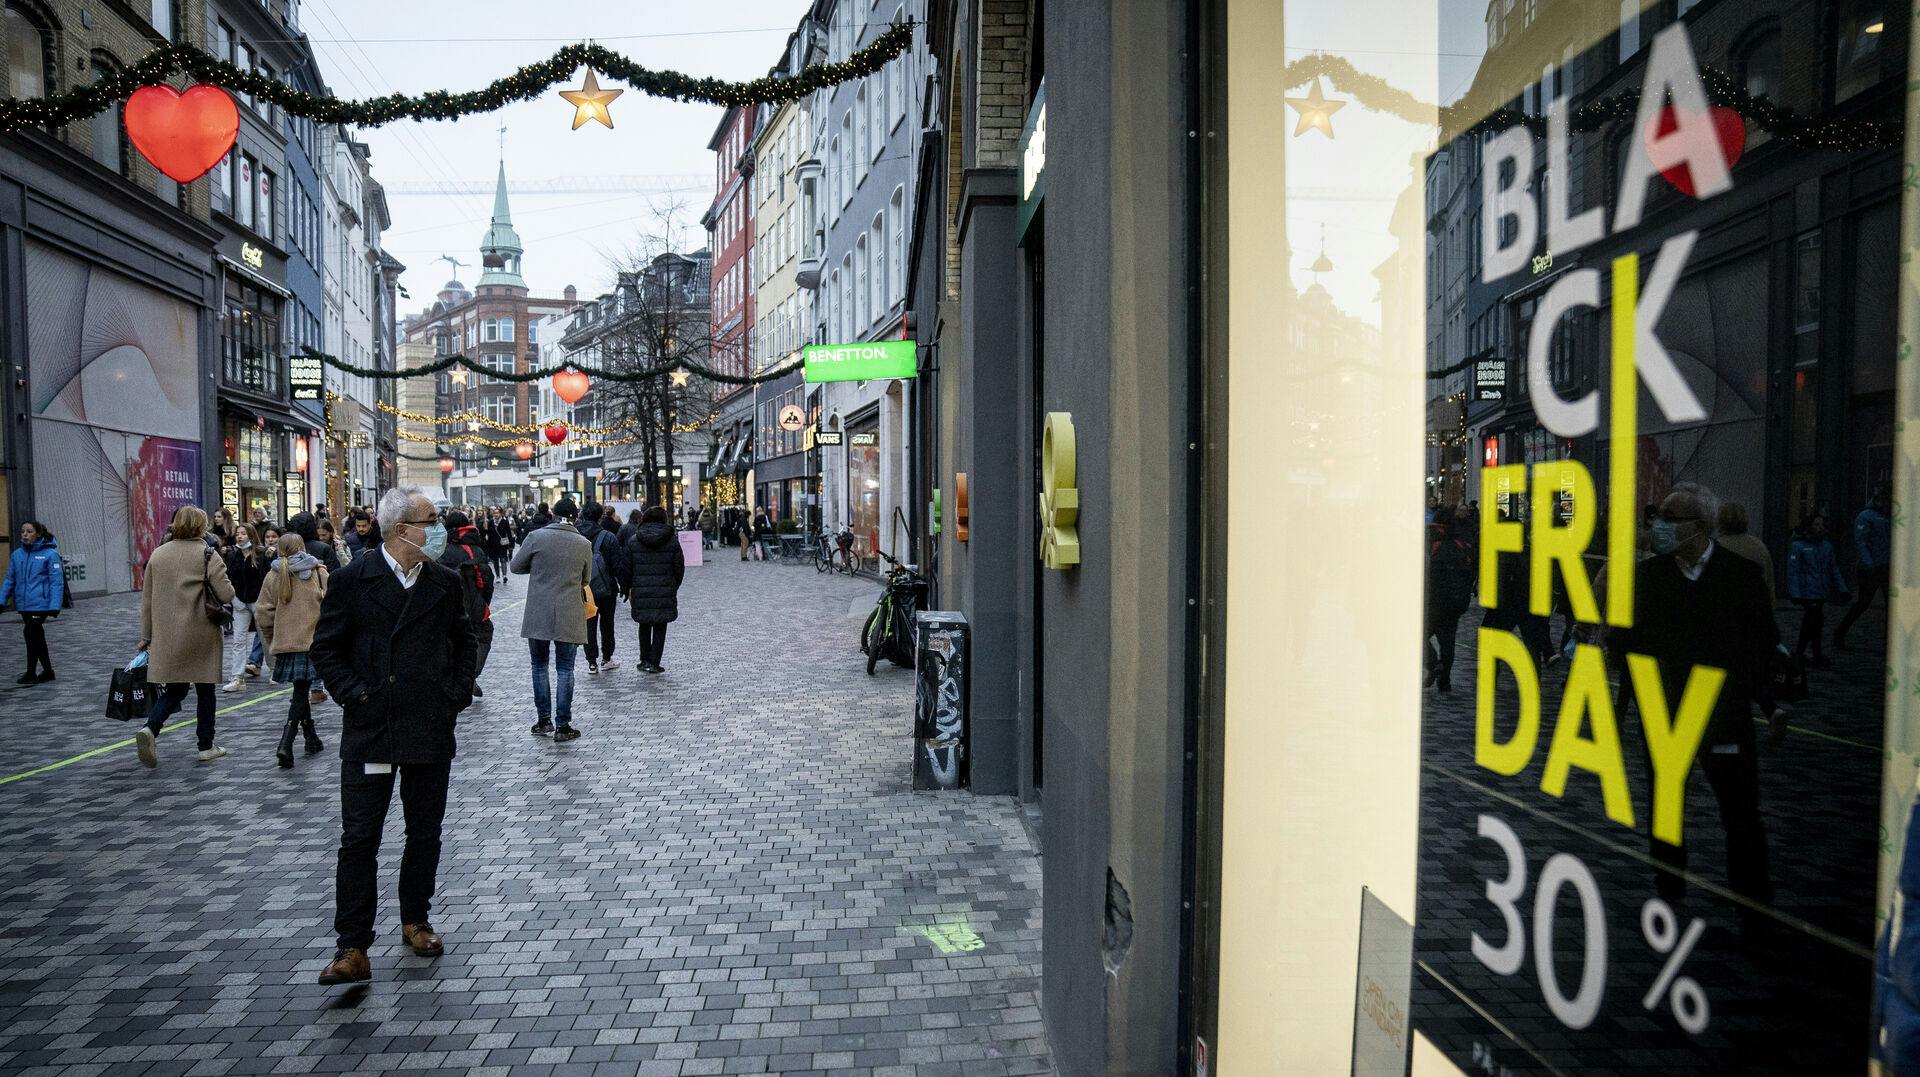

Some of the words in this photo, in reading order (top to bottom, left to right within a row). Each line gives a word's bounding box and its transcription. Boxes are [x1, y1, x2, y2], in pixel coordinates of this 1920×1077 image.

[290, 367, 322, 379] HOUSE
[815, 433, 841, 444] VANS
[1478, 252, 1638, 628] FRI
[165, 470, 190, 483] RETAIL
[162, 487, 193, 500] SCIENCE
[1475, 627, 1728, 848] DAY
[1470, 814, 1608, 1030] 30
[1640, 898, 1710, 1034] %
